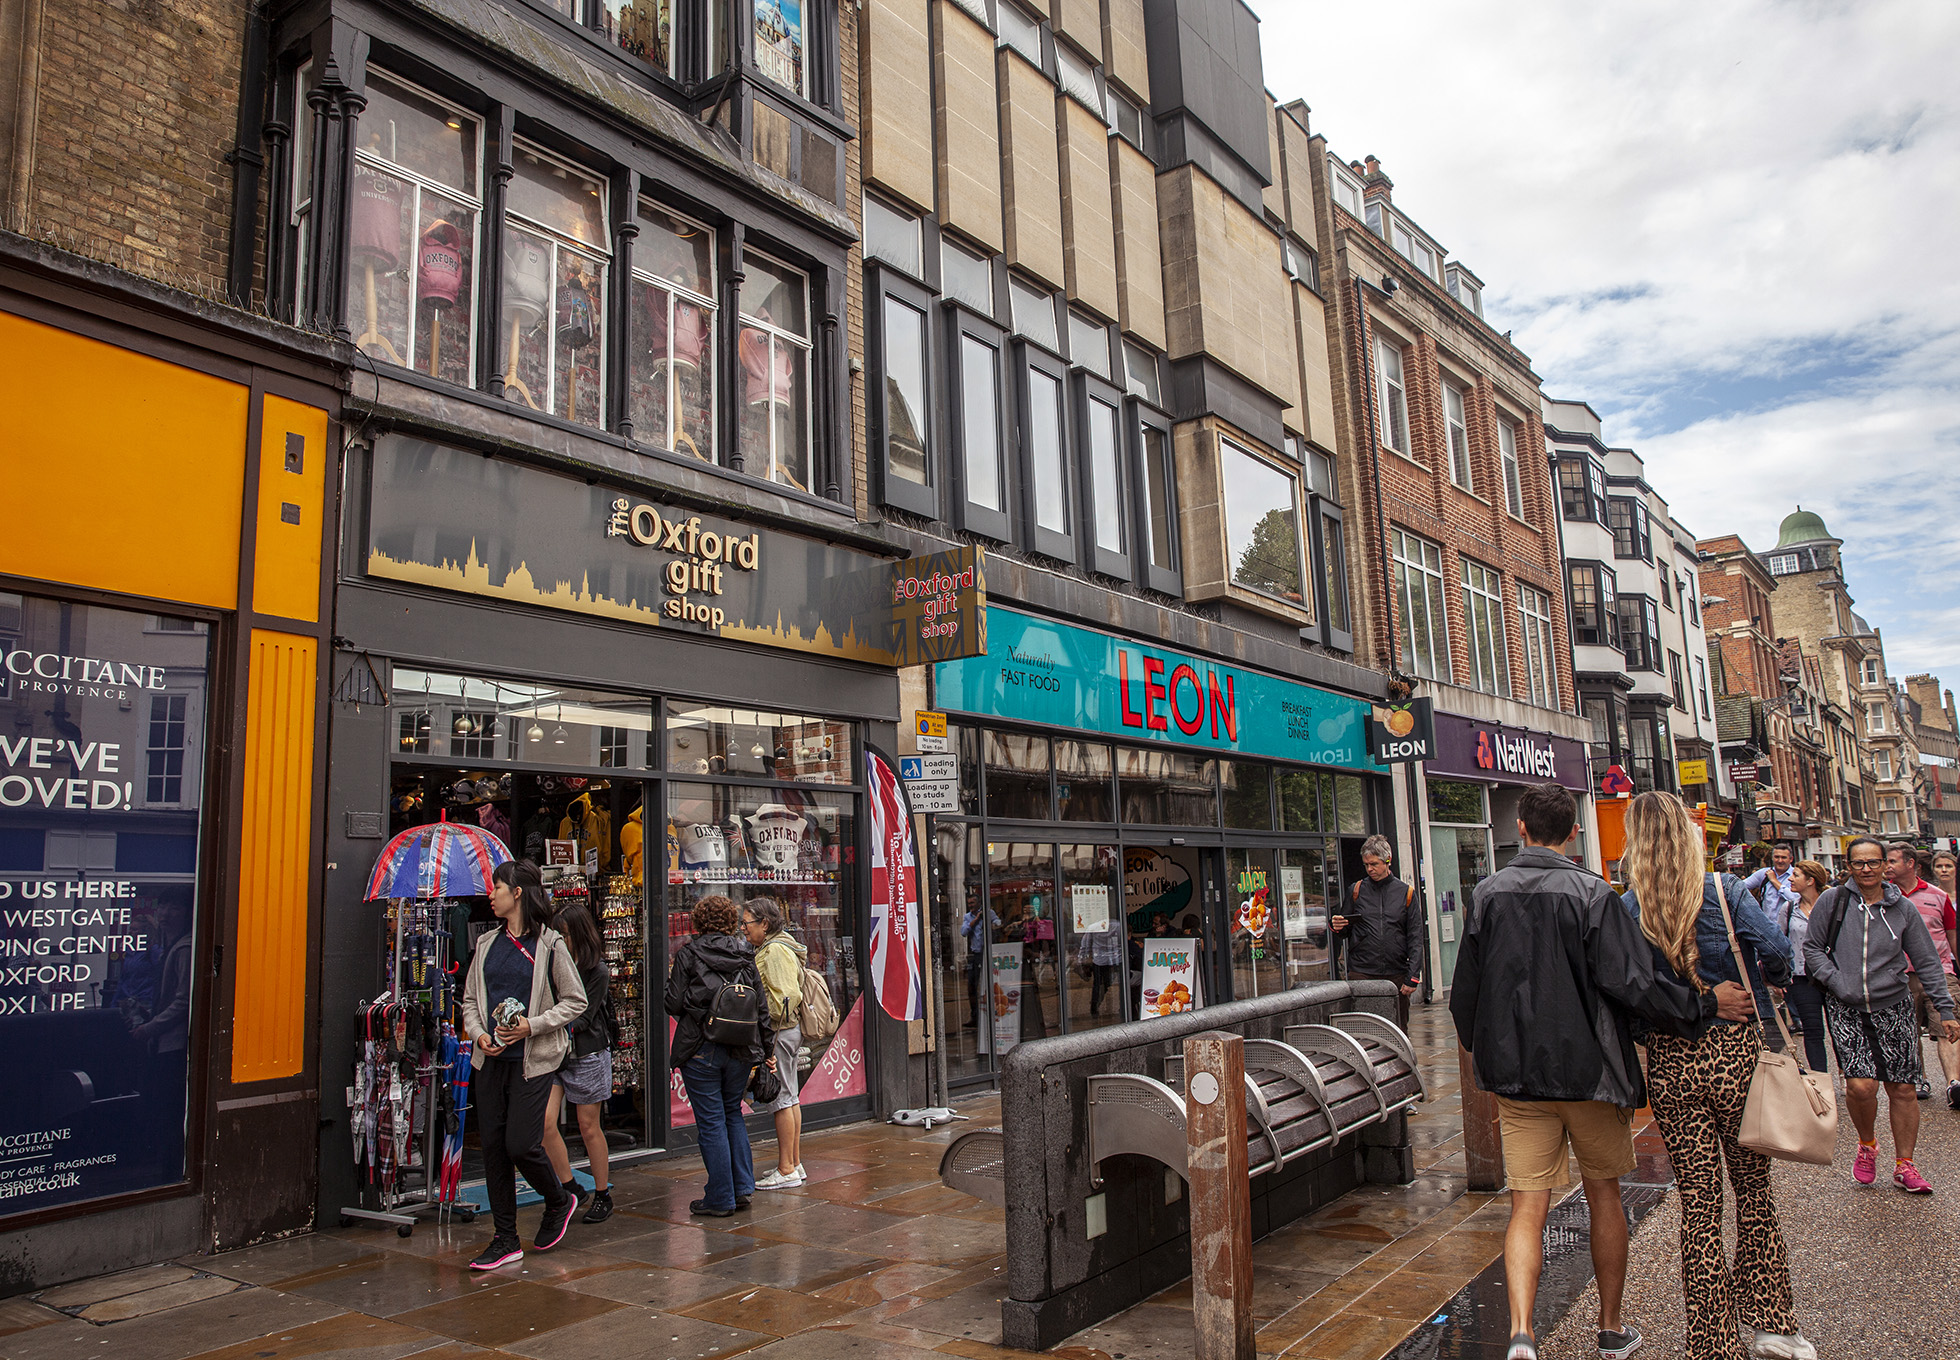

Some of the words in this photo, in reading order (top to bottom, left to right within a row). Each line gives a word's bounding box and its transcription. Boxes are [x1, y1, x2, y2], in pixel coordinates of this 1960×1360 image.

[426, 253, 458, 272] OXFORD
[609, 498, 629, 537] The
[639, 504, 759, 571] Oxford
[667, 557, 723, 596] gift
[903, 565, 974, 600] Oxford
[674, 596, 725, 630] shop
[923, 592, 958, 622] gift
[921, 621, 958, 639] shop
[0, 648, 166, 690] CCITANE
[1006, 644, 1056, 674] Naturally
[19, 680, 127, 700] PROVENCE
[1001, 668, 1026, 687] FAST
[1029, 673, 1060, 692] FOOD
[1118, 649, 1237, 742] LEON
[1282, 701, 1312, 718] BREAKFAST
[1287, 714, 1309, 729] LUNCH
[1287, 727, 1311, 742] DINNER
[1381, 739, 1427, 759] LEON
[1494, 733, 1557, 778] NatWest
[924, 760, 955, 768] Loading
[931, 768, 948, 776] only
[0, 775, 132, 811] OVED!
[761, 843, 797, 852] UNVERSITY
[1124, 857, 1158, 873] EON.
[21, 881, 57, 899] US
[65, 881, 137, 899] HERE:
[1237, 871, 1267, 894] JACK
[4, 908, 131, 928] WESTGATE
[58, 934, 147, 954] CENTRE
[1147, 952, 1189, 968] JACK
[1170, 962, 1191, 975] Wings
[0, 964, 91, 986] XFORD
[822, 1034, 848, 1076] 50%
[833, 1047, 862, 1095] sale
[672, 1072, 692, 1107] sa
[0, 1128, 71, 1149] CCITANE
[7, 1143, 53, 1156] PROVENCE
[0, 1169, 15, 1180] DY
[17, 1165, 46, 1177] CARE
[54, 1154, 117, 1171] FRAGRANCES
[0, 1173, 81, 1199] tane.co.uk
